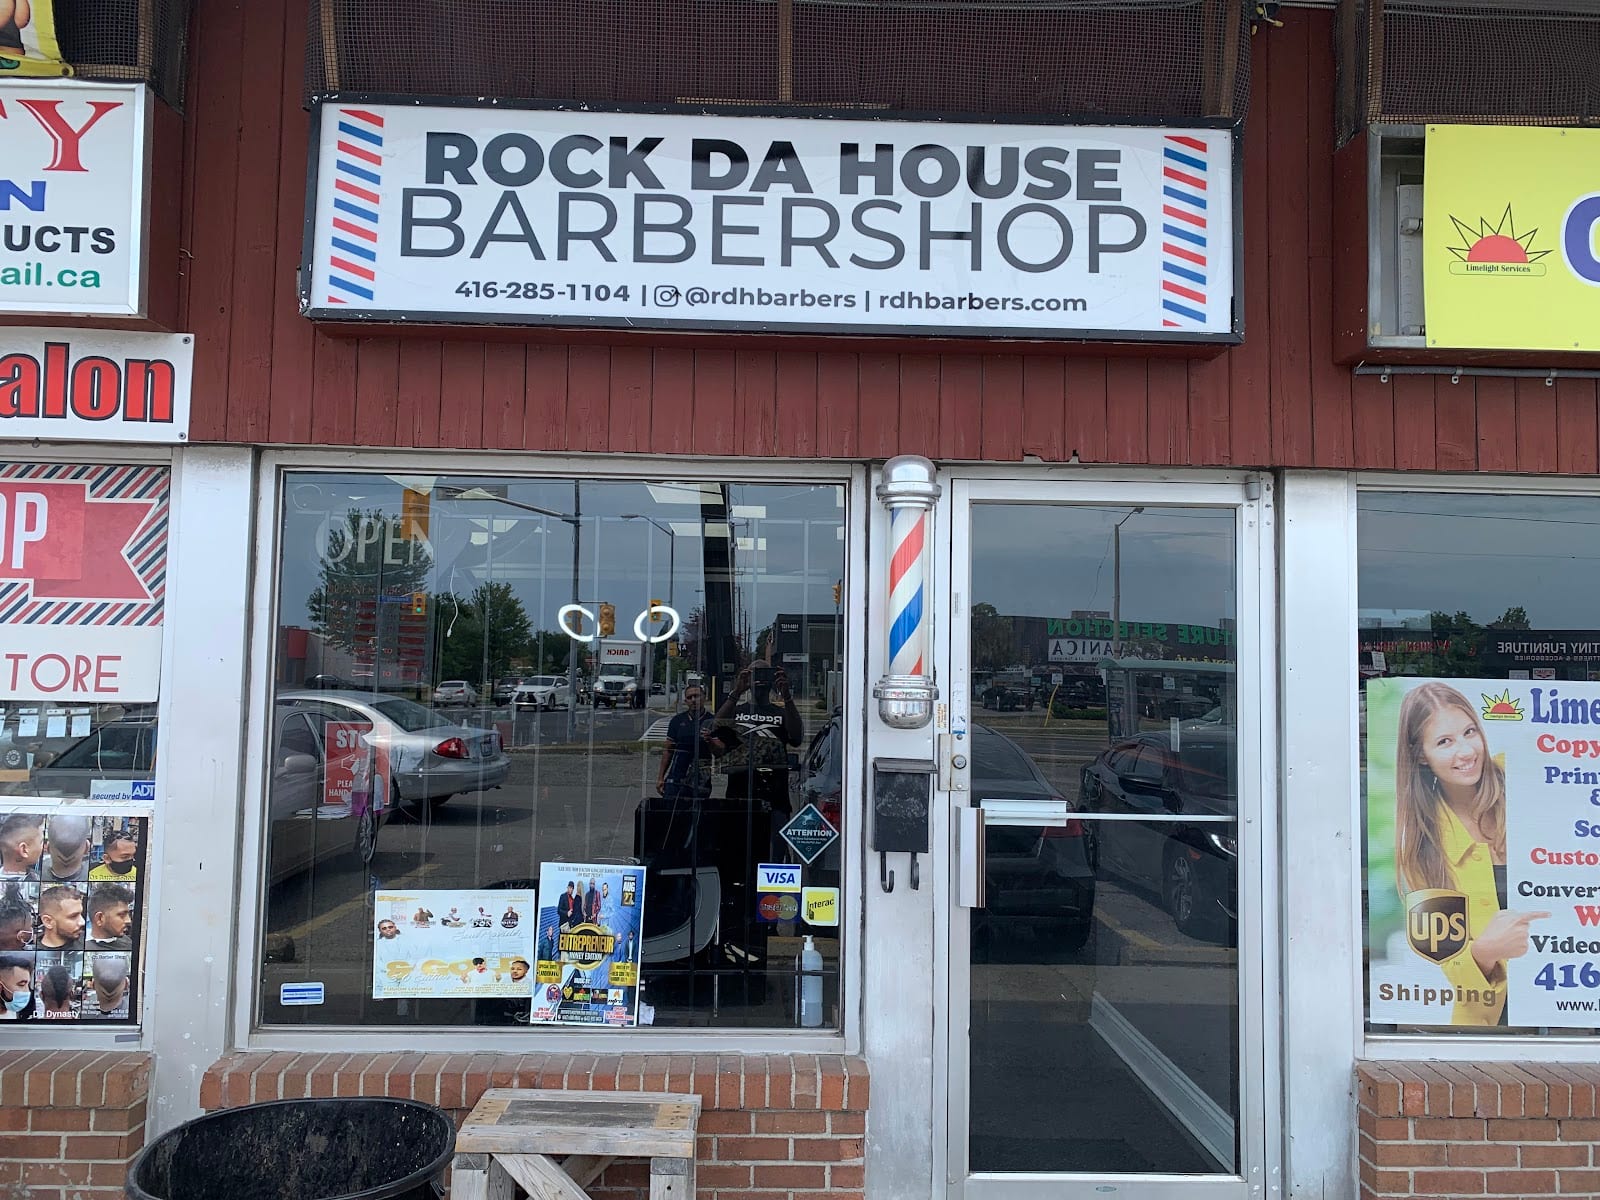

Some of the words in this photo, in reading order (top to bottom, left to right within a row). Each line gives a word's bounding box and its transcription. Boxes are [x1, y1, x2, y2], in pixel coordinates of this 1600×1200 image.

[424, 130, 666, 190] ROCK
[690, 137, 814, 194] DA
[838, 141, 1123, 202] HOUSE
[4, 224, 116, 254] UCTS
[399, 187, 1148, 274] BARBERSHOP
[0, 261, 101, 288] ail.ca
[1466, 263, 1500, 274] Limelight
[1501, 264, 1531, 274] Services
[454, 279, 631, 303] 416-285-1104
[685, 286, 857, 310] @rdhbarbers
[878, 290, 1088, 312] rdhbarbers.com
[0, 341, 176, 424] alon
[315, 514, 434, 566] OPEN
[5, 653, 122, 693] TORE
[1529, 687, 1600, 725] Lime
[1536, 733, 1600, 759] Copy
[1544, 766, 1600, 785] Prin
[91, 792, 121, 800] secured
[121, 792, 132, 800] by
[132, 784, 155, 797] ADT
[786, 828, 832, 837] ATTENTION
[1529, 847, 1600, 866] Custo
[764, 872, 796, 884] VISA
[1517, 880, 1600, 898] Conver
[558, 933, 615, 953] ENTREPRENEUR
[1411, 911, 1467, 953] ups
[1530, 935, 1600, 954] Video
[1534, 961, 1600, 992] 416
[1379, 983, 1497, 1007] Shipping
[46, 1009, 81, 1020] Dynasty
